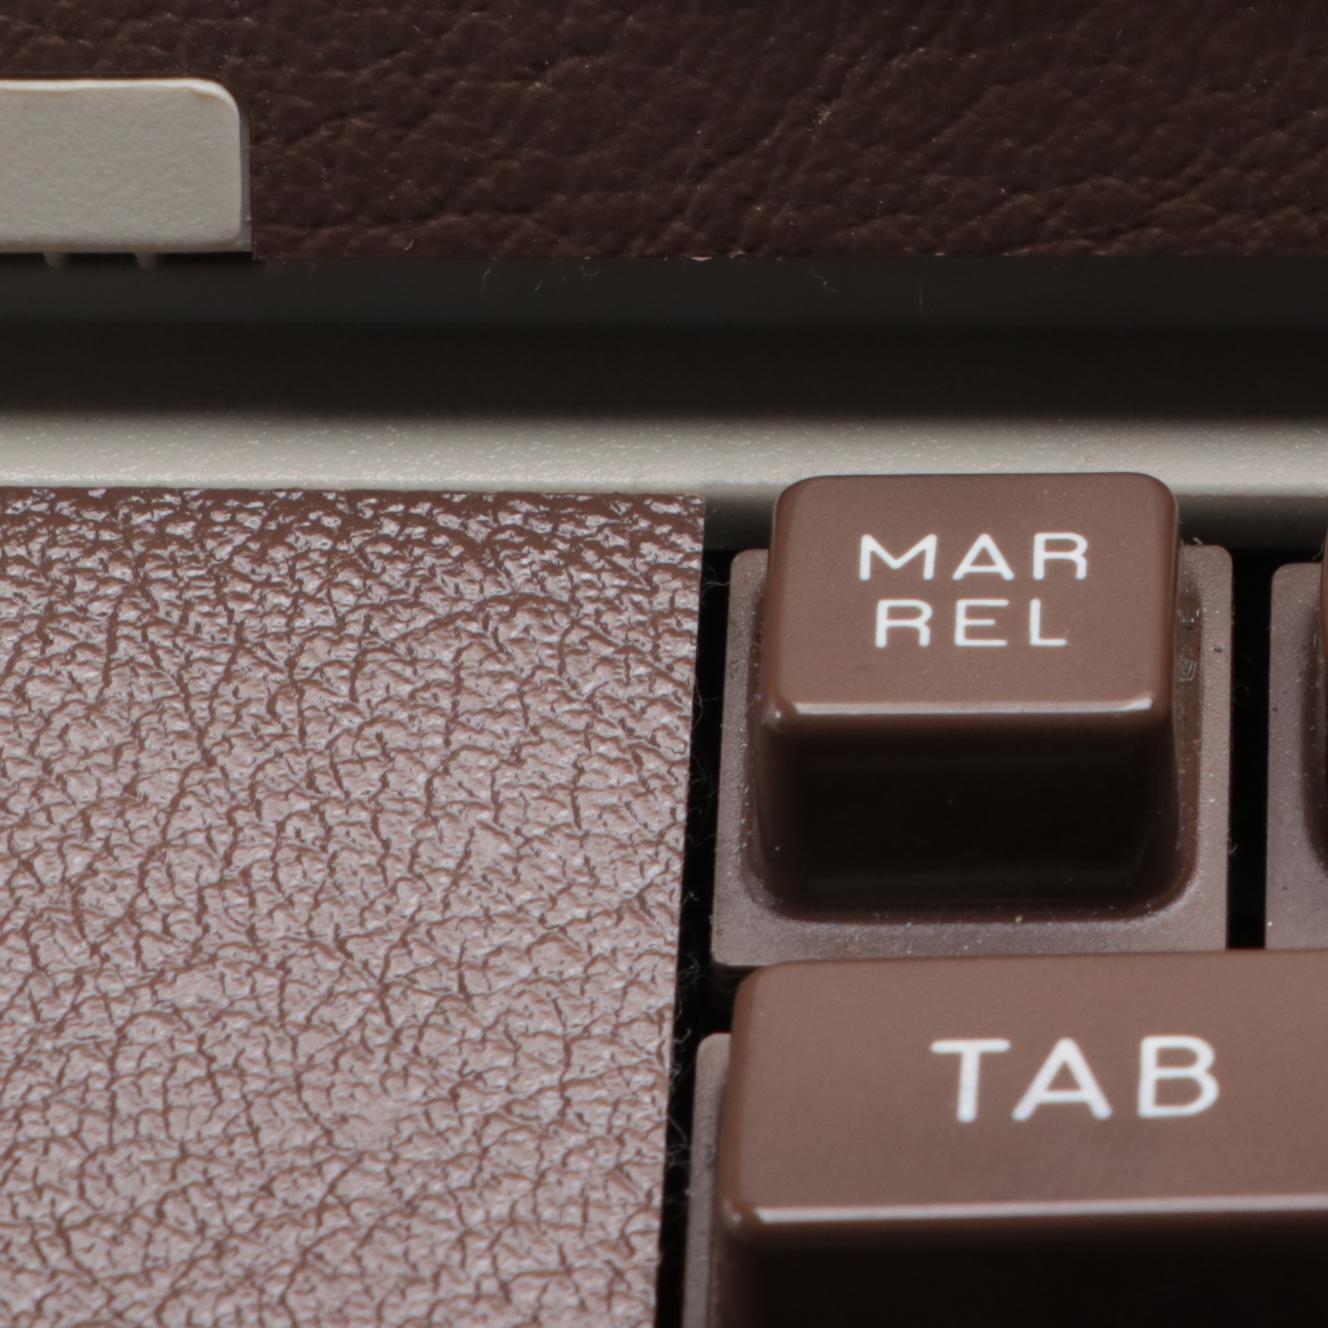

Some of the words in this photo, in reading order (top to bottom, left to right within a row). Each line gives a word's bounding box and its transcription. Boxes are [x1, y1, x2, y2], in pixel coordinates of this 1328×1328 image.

[858, 532, 1089, 581] MAR
[874, 598, 1068, 649] REL
[930, 1035, 1220, 1123] TAB
